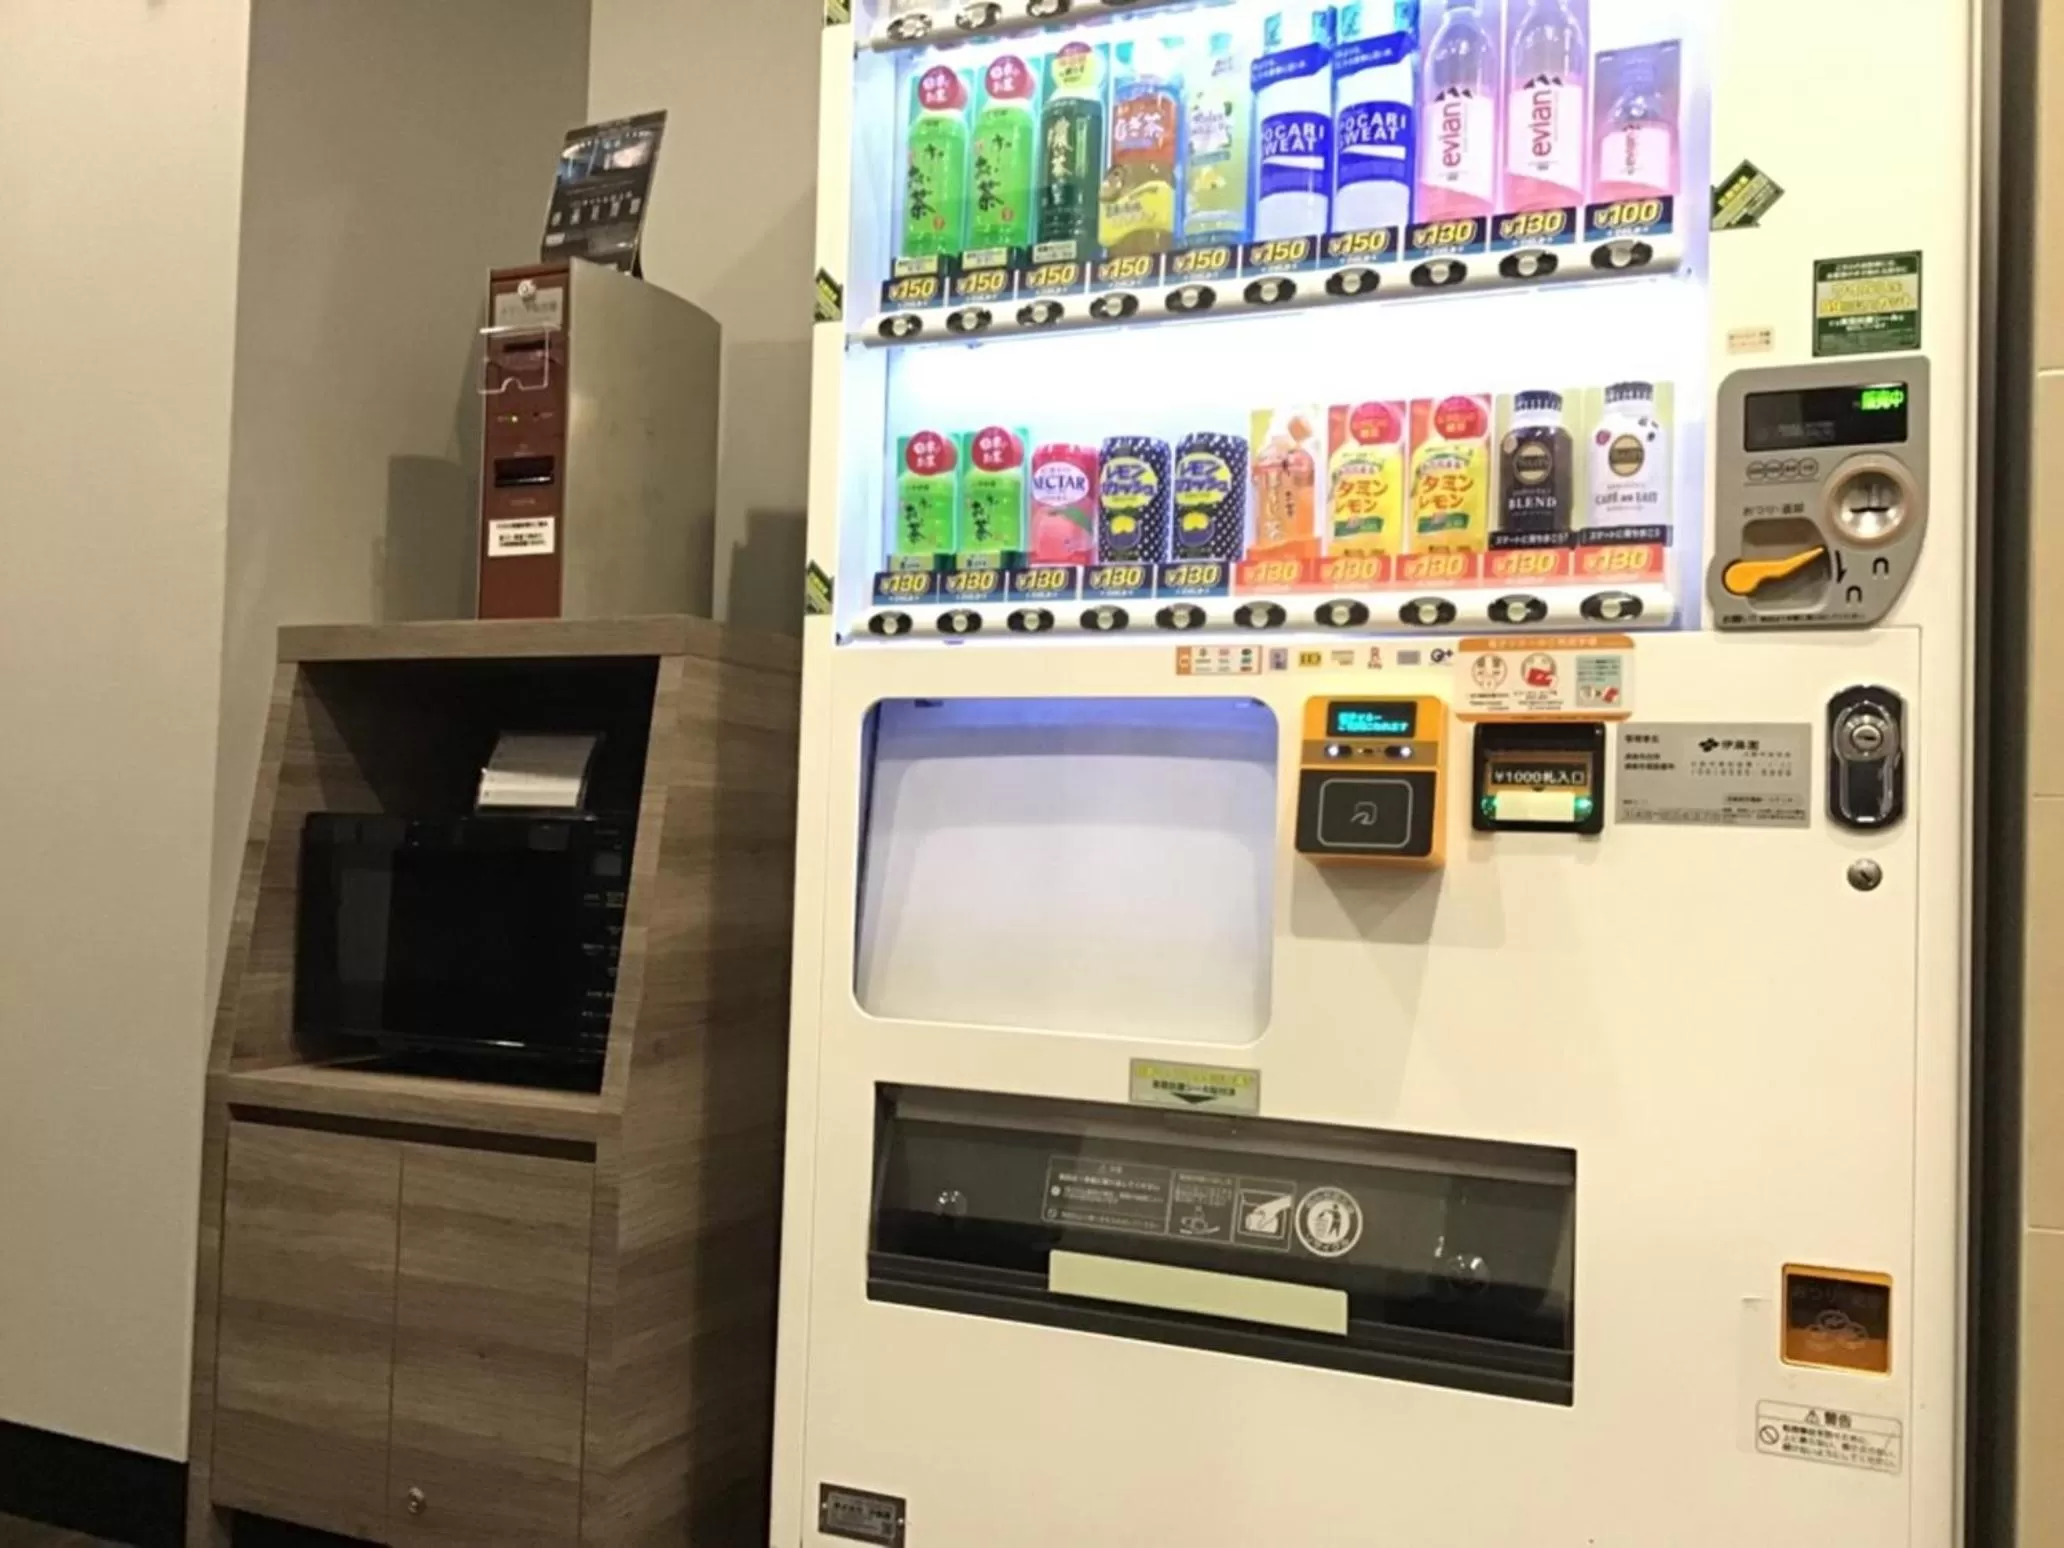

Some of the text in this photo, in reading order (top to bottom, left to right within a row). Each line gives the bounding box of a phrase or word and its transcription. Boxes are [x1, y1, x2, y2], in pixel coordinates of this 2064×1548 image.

[1262, 122, 1325, 141] OCARI
[1341, 112, 1407, 132] OCARI
[1442, 98, 1461, 168] evian
[1532, 89, 1552, 158] evian
[1262, 137, 1318, 156] WEAT
[1341, 128, 1399, 148] WEAT
[1501, 211, 1564, 236] ¥130
[1594, 202, 1660, 226] ¥100
[1331, 230, 1388, 256] ¥150
[1414, 220, 1475, 245] ¥130
[1175, 249, 1227, 273] ¥150
[1252, 238, 1307, 263] ¥150
[1027, 262, 1077, 288] ¥150
[1100, 256, 1151, 279] ¥150
[1337, 479, 1389, 498] タミン
[1421, 475, 1474, 494] タミン
[1335, 498, 1378, 514] レモン
[1418, 494, 1465, 510] レモン
[1507, 495, 1557, 511] BLEND
[881, 574, 929, 595] ¥130
[946, 572, 994, 593] ¥130
[1017, 569, 1066, 591] ¥130
[1092, 565, 1143, 588] ¥130
[1166, 563, 1218, 585] ¥130
[1493, 768, 1586, 786] ¥1000札入口
